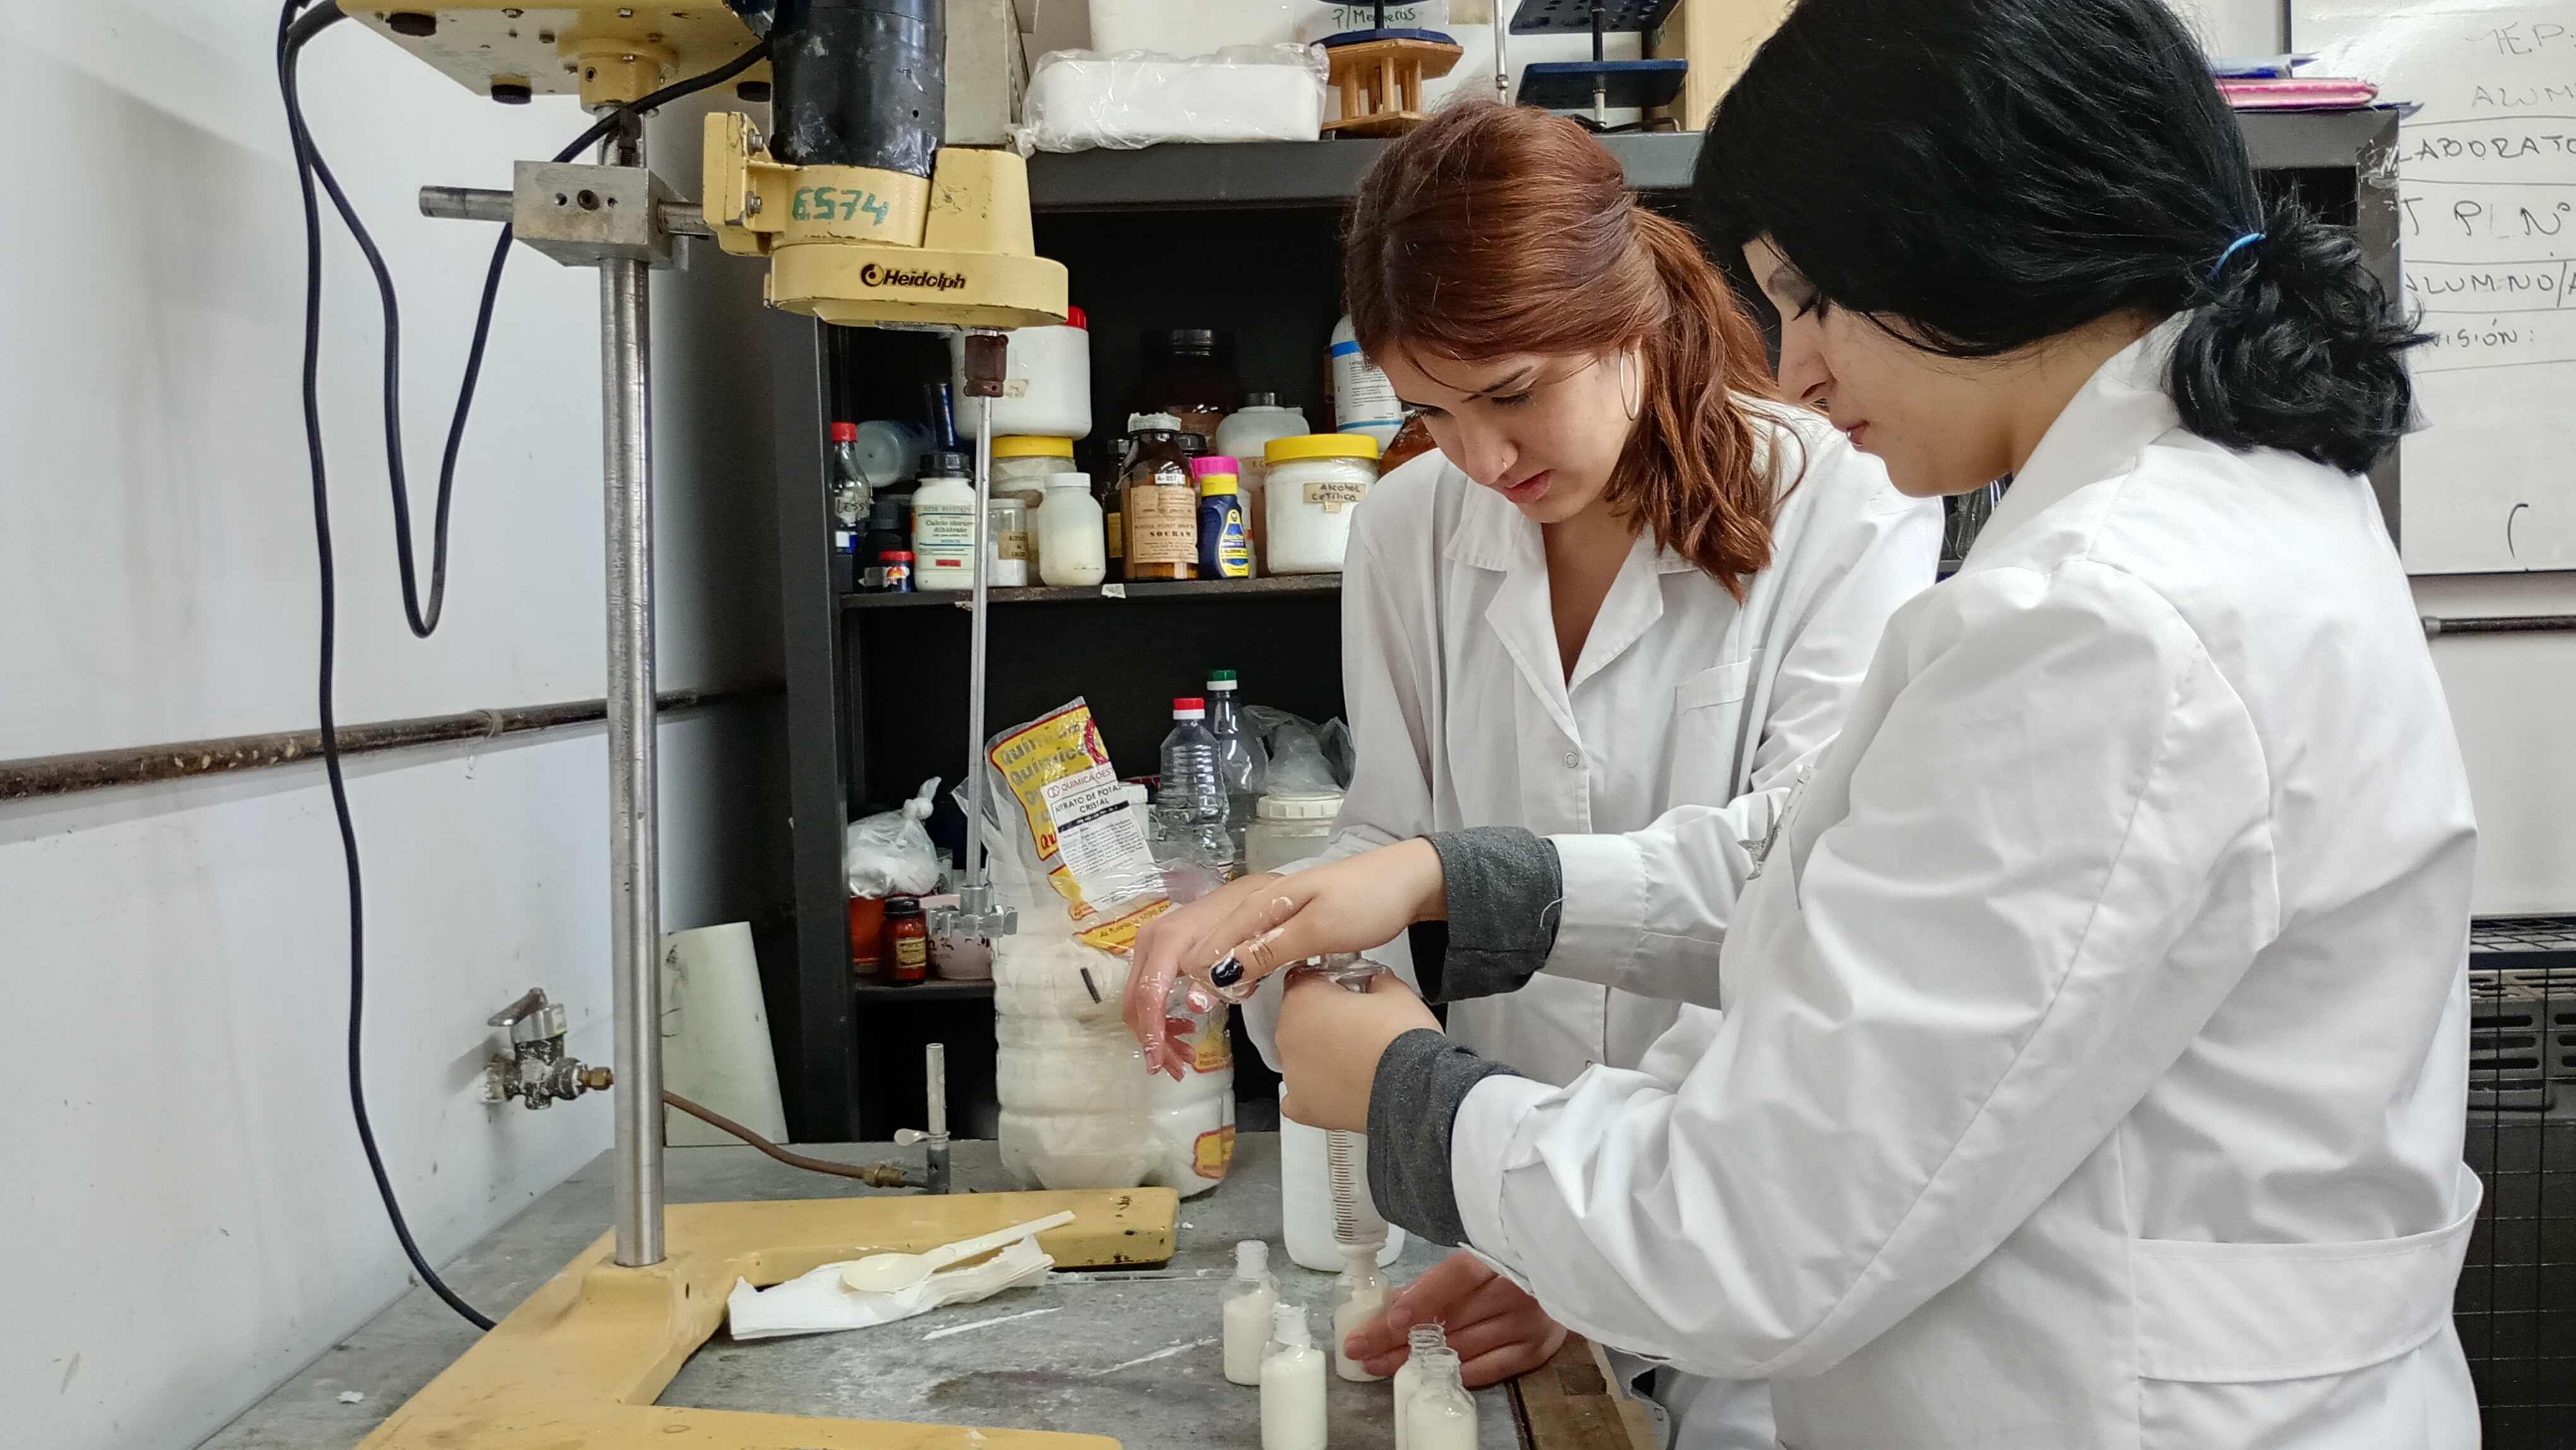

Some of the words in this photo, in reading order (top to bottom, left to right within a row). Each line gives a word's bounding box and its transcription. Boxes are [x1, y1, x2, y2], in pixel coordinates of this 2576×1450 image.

[2471, 83, 2576, 108] ALUM
[883, 269, 967, 292] Heidolph
[1061, 774, 1094, 791] QUIMICA
[1079, 797, 1110, 813] CRISTAL
[1085, 792, 1097, 801] DE
